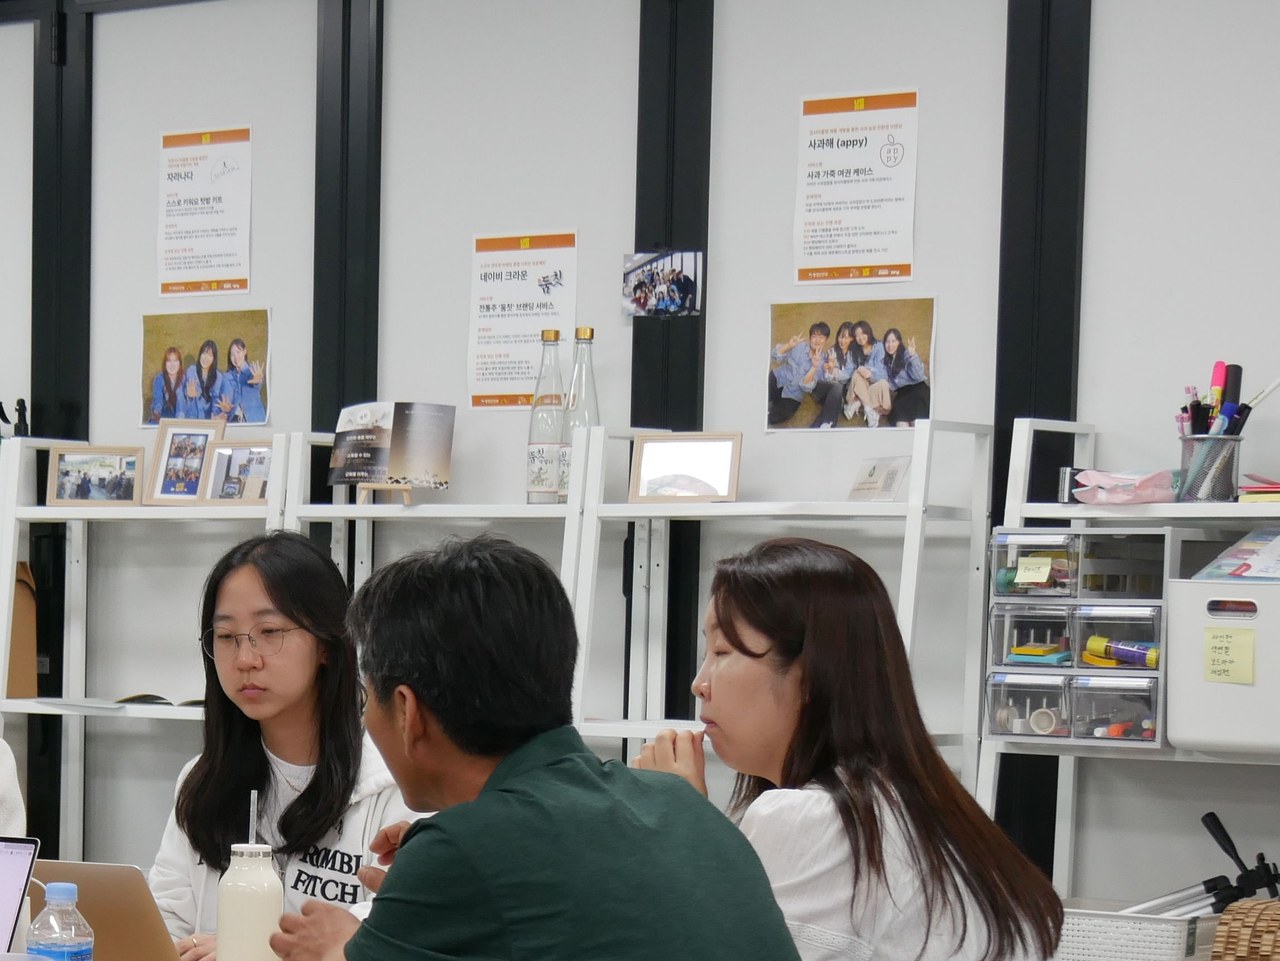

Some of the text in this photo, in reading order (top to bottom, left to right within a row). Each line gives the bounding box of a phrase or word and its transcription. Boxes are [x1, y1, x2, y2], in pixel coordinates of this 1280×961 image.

[808, 136, 868, 150] 사과해 (appy)
[167, 170, 193, 182] 자라나다
[807, 167, 874, 180] 사과 가죽 여권 케이스
[166, 199, 181, 207] 스스로
[480, 270, 528, 282] 네이비 크라운
[516, 302, 535, 311] 브랜딩
[536, 301, 554, 310] 서비스
